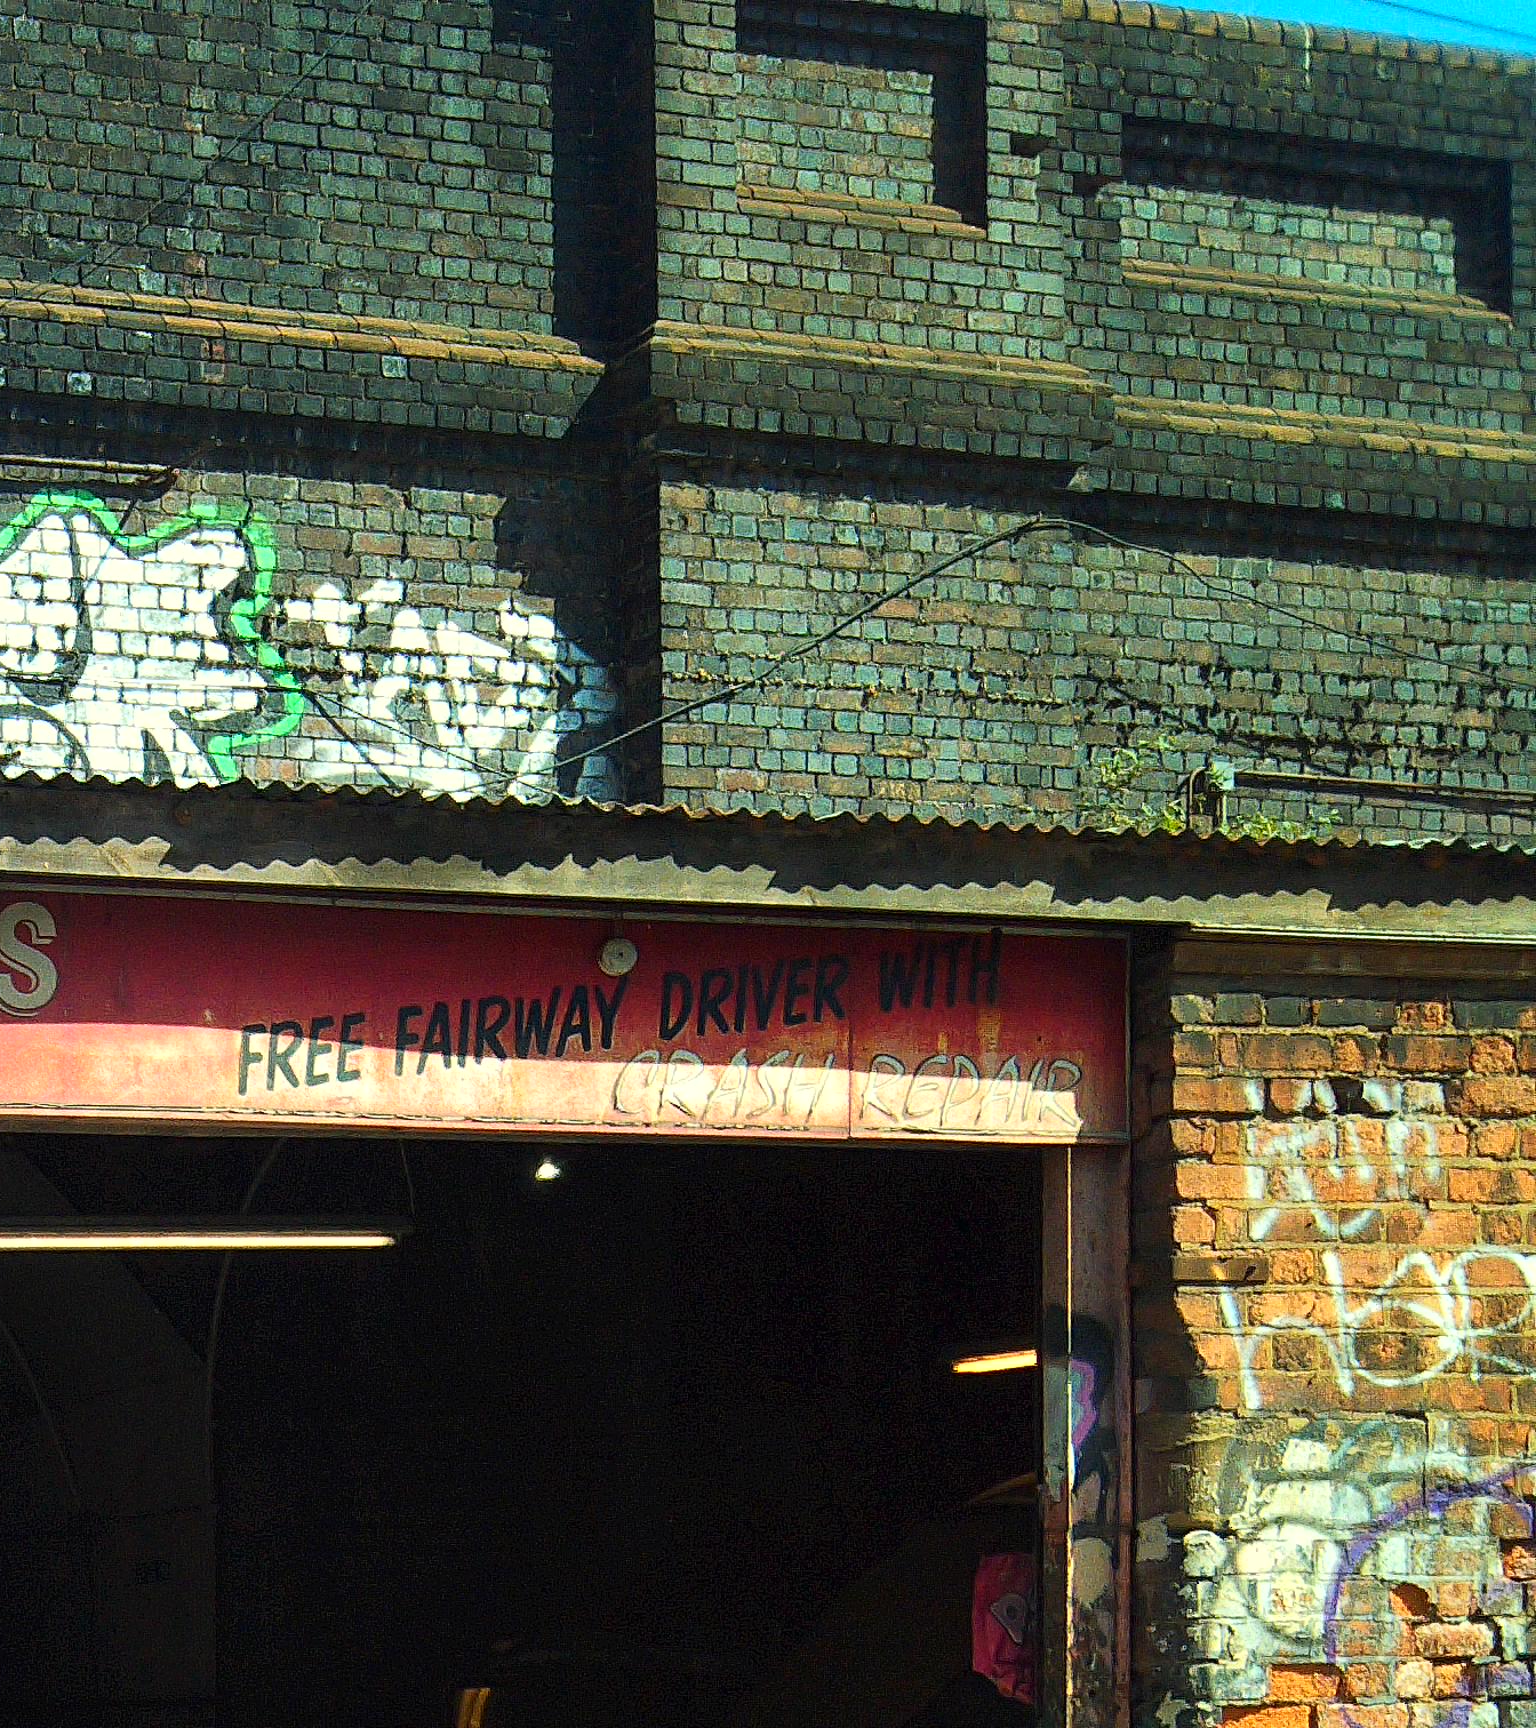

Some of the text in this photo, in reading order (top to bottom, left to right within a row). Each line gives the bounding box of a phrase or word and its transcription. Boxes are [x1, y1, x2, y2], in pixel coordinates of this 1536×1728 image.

[238, 927, 1003, 1096] FREE FAIRWAY DRIVER WITH
[612, 1047, 1084, 1129] CRASH REPAIR
